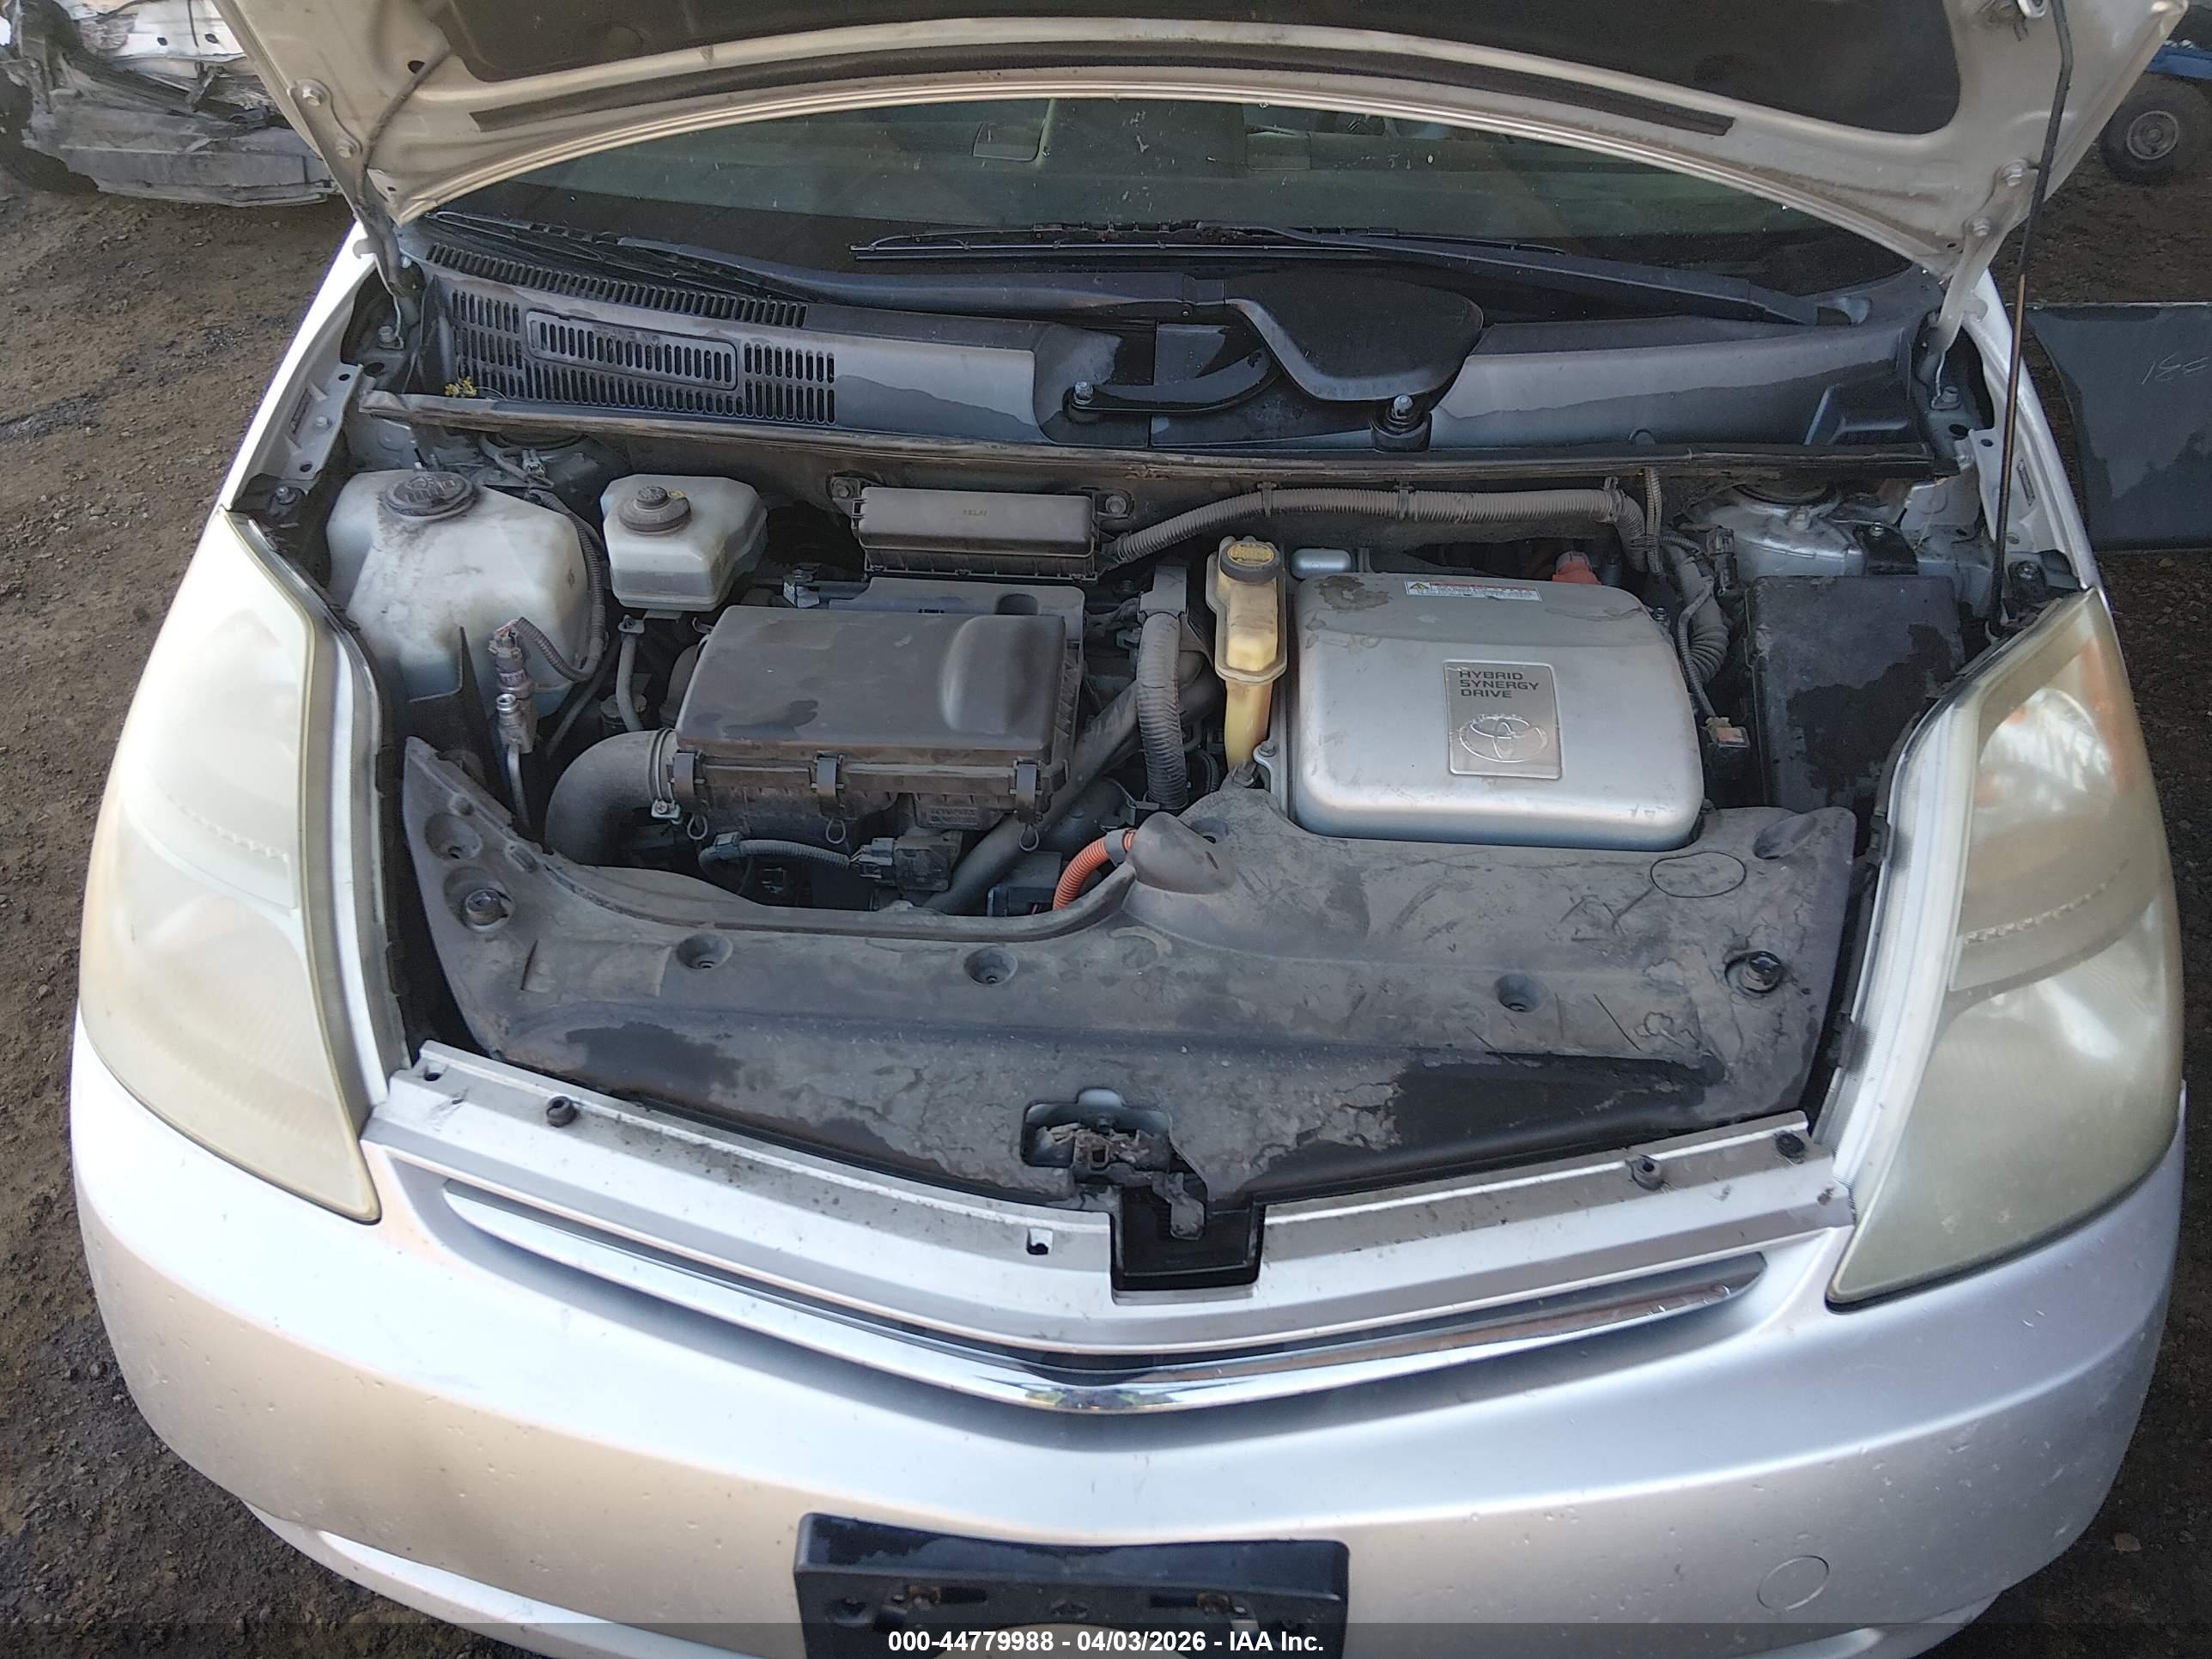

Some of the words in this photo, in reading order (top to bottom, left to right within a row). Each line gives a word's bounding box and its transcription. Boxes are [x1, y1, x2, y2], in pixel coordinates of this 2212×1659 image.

[1460, 670, 1523, 680] HYBRID
[1460, 679, 1539, 690] SYNERGY
[1461, 689, 1512, 698] DRIVE
